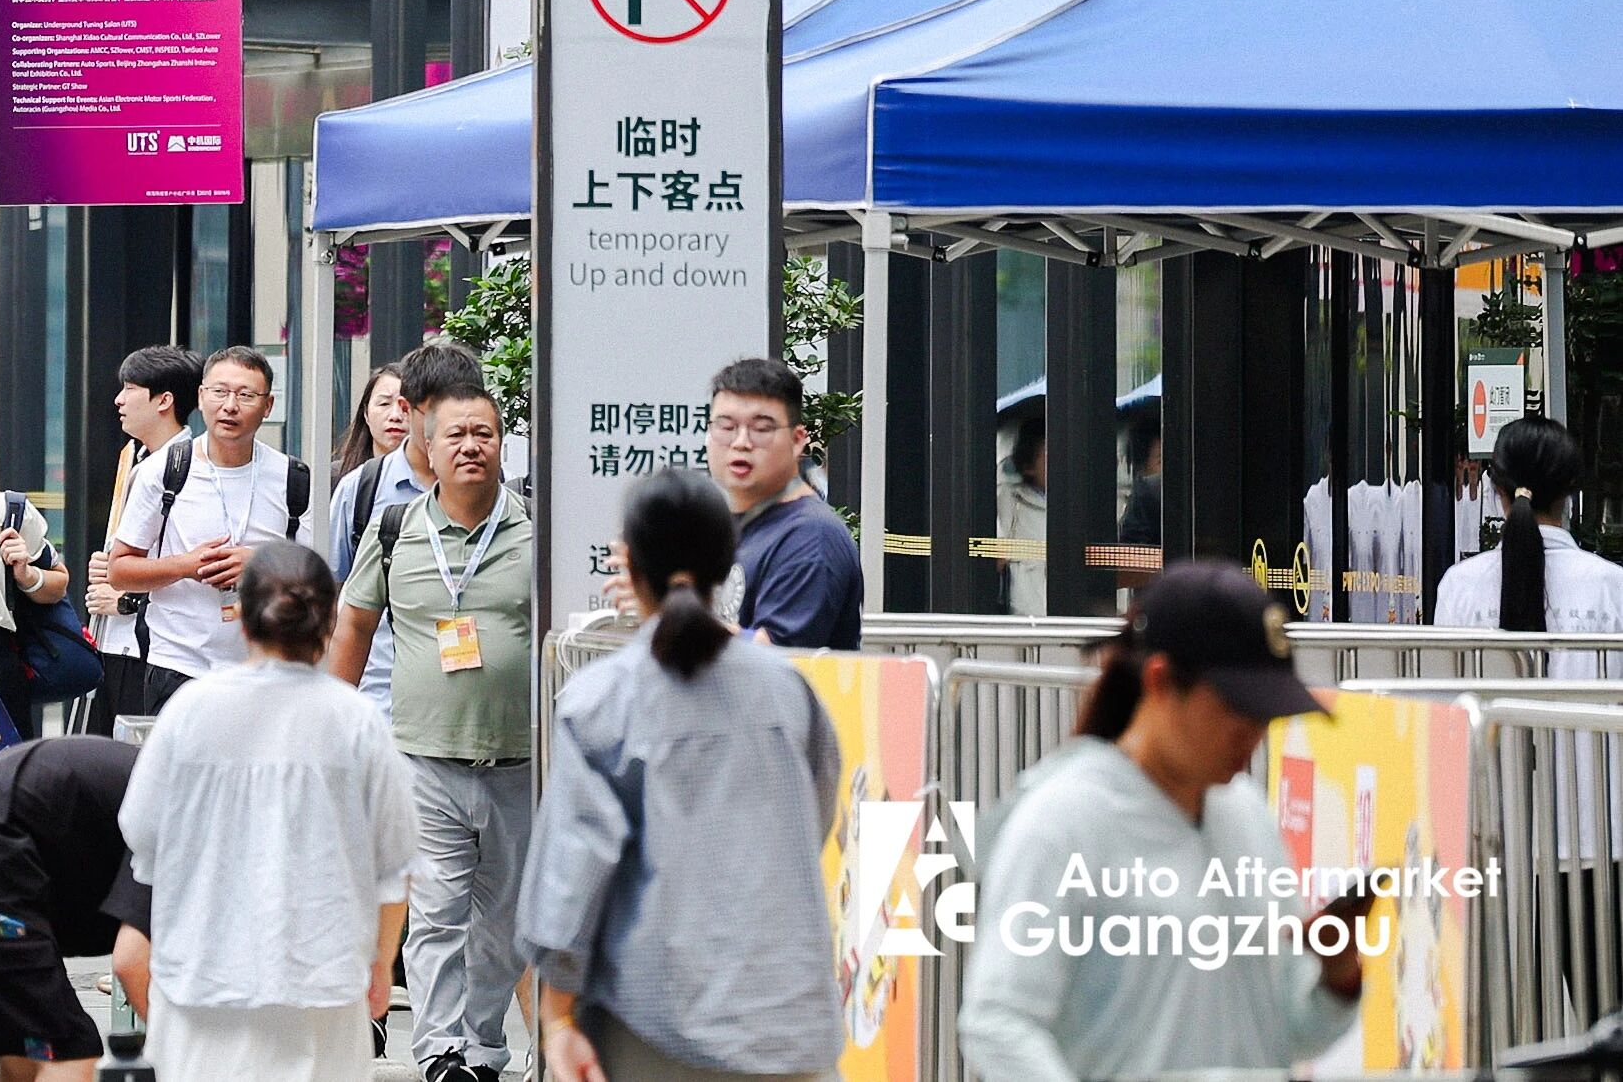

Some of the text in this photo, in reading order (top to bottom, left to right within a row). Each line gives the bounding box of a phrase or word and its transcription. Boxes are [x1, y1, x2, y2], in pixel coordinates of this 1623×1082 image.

[12, 48, 45, 56] Supporting
[128, 133, 158, 152] UTS
[618, 117, 700, 156] 临时
[573, 170, 744, 211] 上下客点
[589, 229, 729, 258] temporary
[570, 262, 746, 291] Up and down
